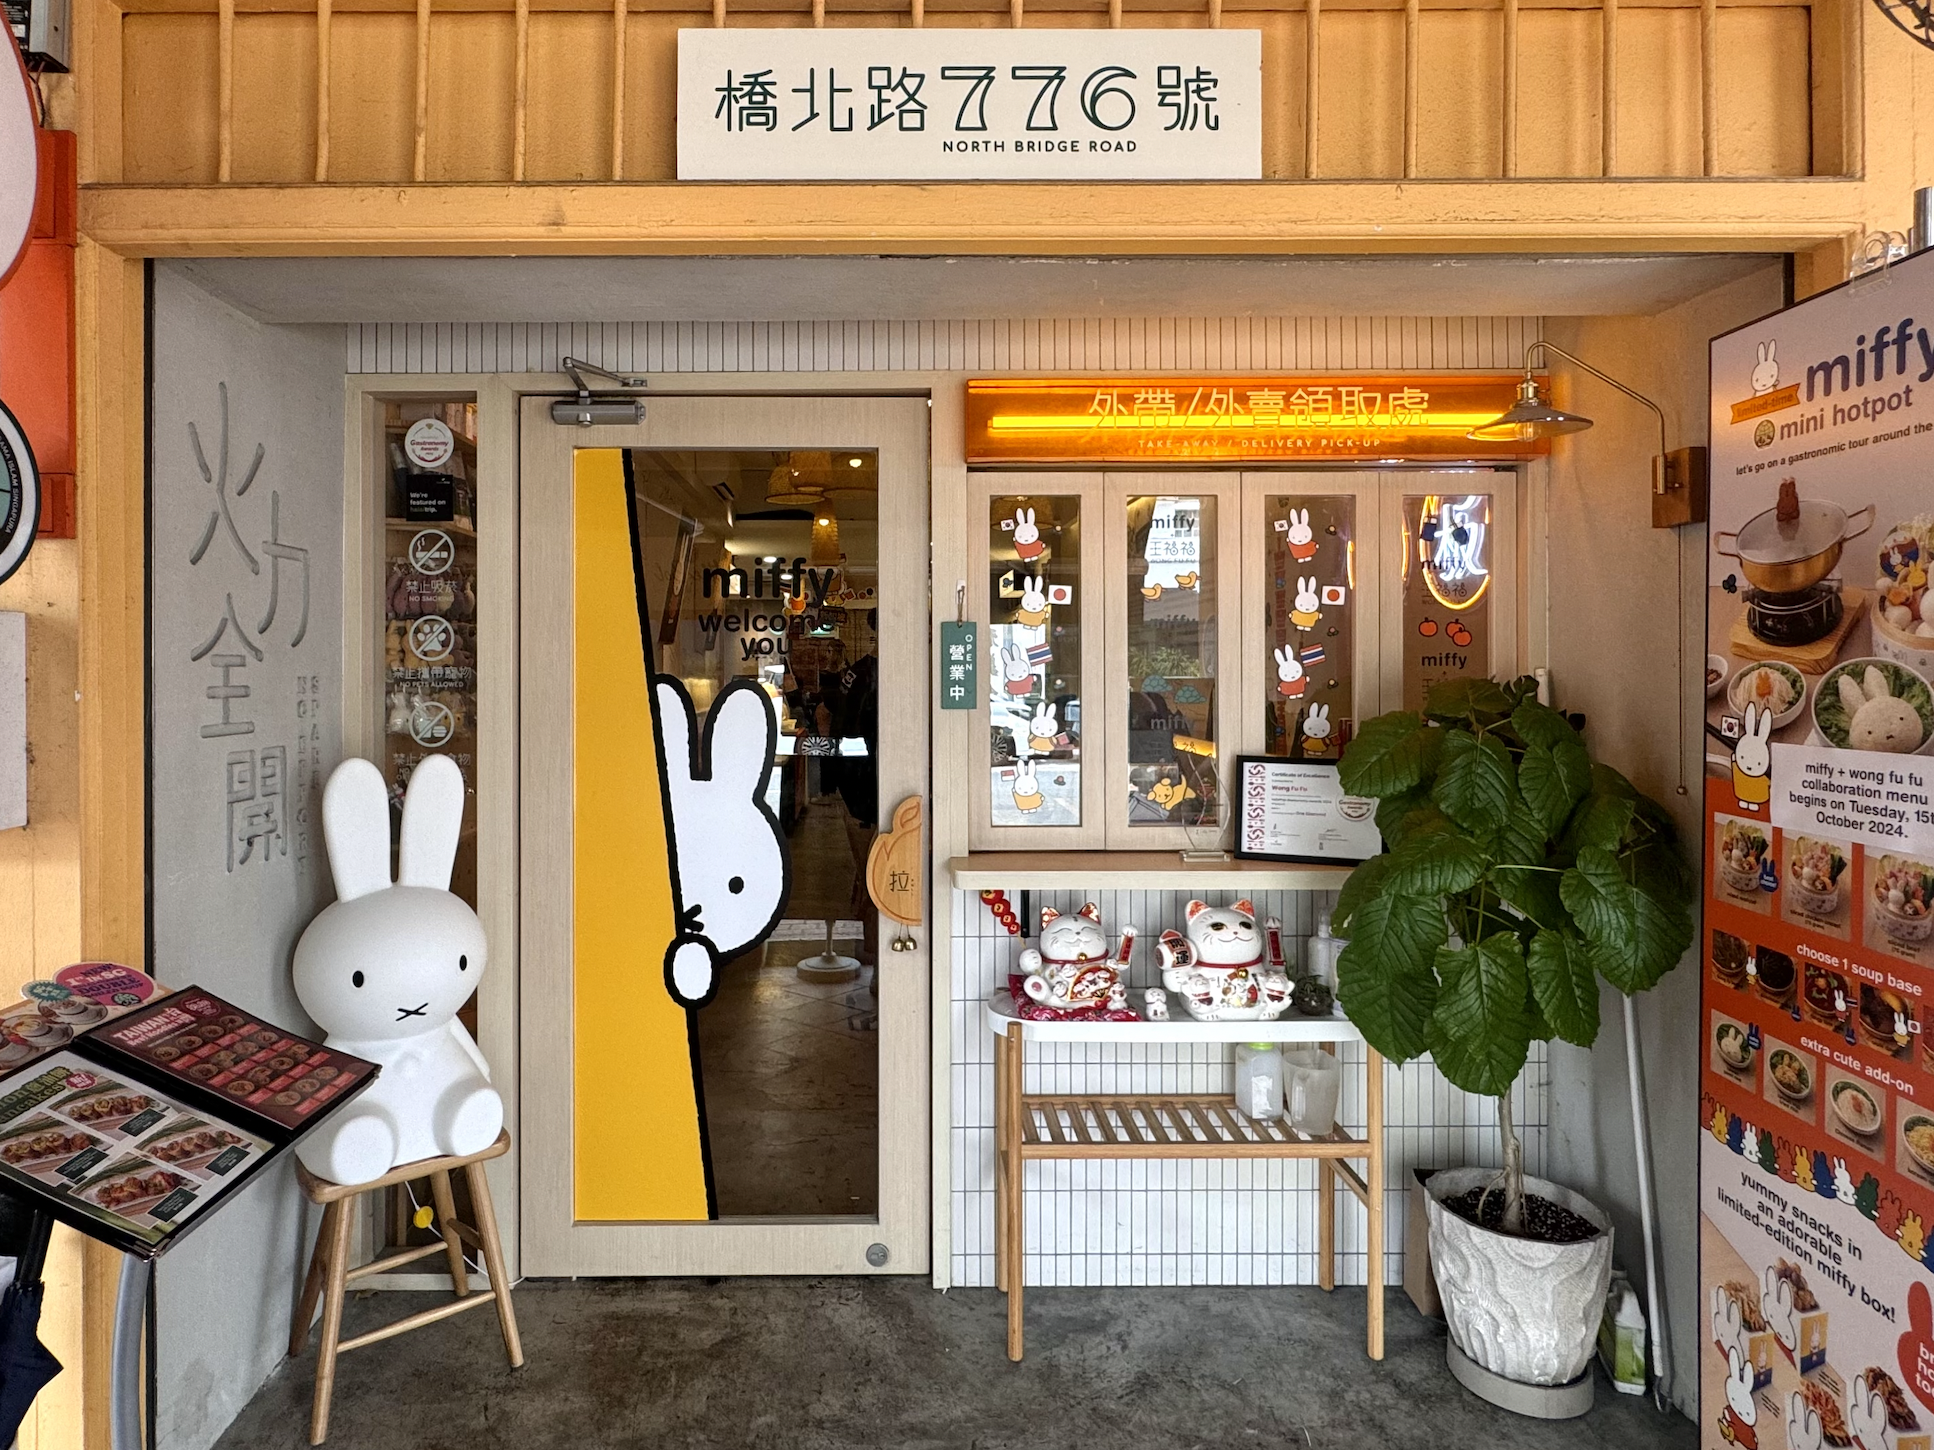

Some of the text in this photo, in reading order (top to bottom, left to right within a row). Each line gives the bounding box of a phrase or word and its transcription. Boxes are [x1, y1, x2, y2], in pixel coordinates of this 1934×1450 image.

[714, 66, 1220, 131] 橋北路776號
[942, 140, 1138, 153] NORTH BRIDGE ROAD
[1806, 318, 1934, 402] miffy
[1779, 385, 1913, 440] mini hotpot
[1138, 438, 1220, 448] TAKE-AWAY
[1241, 438, 1313, 448] DELIVERY
[1321, 437, 1382, 447] PICK-UP
[1736, 422, 1933, 476] let's go on a gastronomic tour around the
[8, 459, 18, 487] ISLAM
[5, 488, 19, 533] SINGAPURA
[1150, 514, 1195, 532] miffy
[406, 580, 458, 594] 禁止吸菸
[703, 556, 834, 608] miffy
[740, 637, 792, 661] you
[965, 634, 973, 671] OPEN
[1421, 653, 1467, 669] miffy
[949, 644, 965, 701] 營業中
[1150, 714, 1192, 731] miff
[1271, 785, 1290, 793] Wong
[1805, 763, 1834, 779] miffy
[1849, 769, 1884, 785] wong
[1889, 771, 1904, 784] fu
[1908, 773, 1923, 787] fu
[1801, 778, 1928, 805] collaboration menu
[1789, 791, 1827, 808] begins
[1830, 799, 1845, 811] on
[1849, 800, 1910, 823] Tuesday,
[1816, 811, 1908, 838] October 2024.
[889, 870, 910, 893] 拉
[101, 968, 127, 979] SG
[1796, 942, 1922, 996] choose 1 soup base
[1800, 1035, 1914, 1095] extra cute add-on
[1740, 1171, 1862, 1260] yummy snacks in
[1757, 1201, 1842, 1265] an adorable
[1717, 1187, 1896, 1323] limited-edition miffy box!
